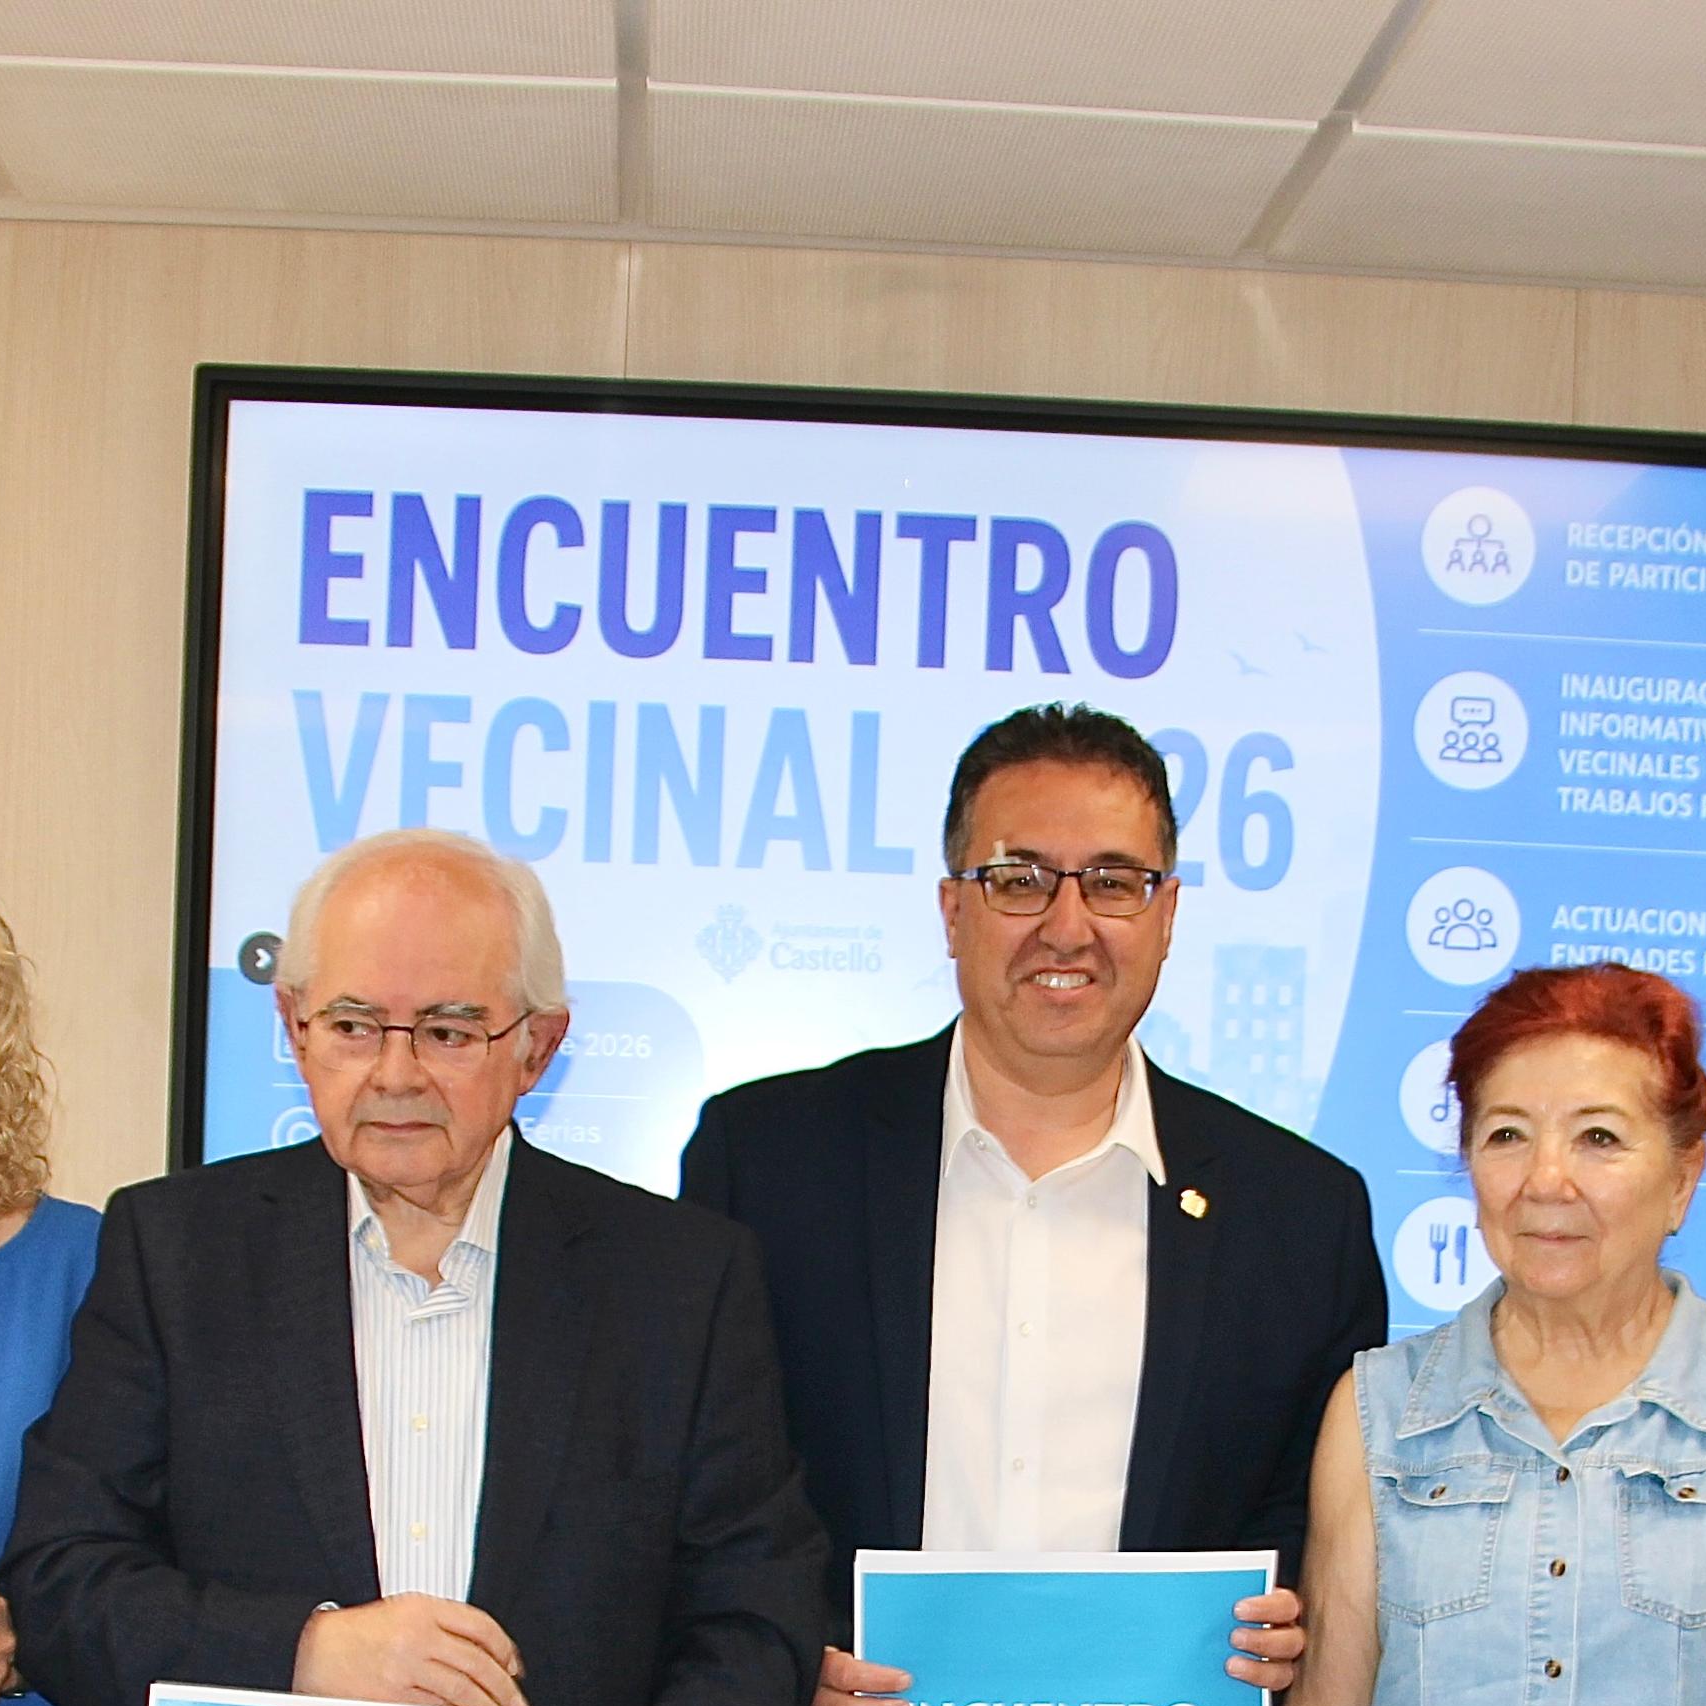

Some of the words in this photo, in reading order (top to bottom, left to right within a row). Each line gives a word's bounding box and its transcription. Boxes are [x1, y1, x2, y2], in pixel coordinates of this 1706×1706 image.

[297, 488, 1179, 679] ENCUENTRO
[1566, 561, 1600, 588] DE
[1559, 749, 1700, 781] VECINALES
[292, 689, 915, 876] VECINAL
[1153, 729, 1296, 891] 26
[1557, 787, 1693, 818] TRABAJOS
[770, 941, 883, 972] Castelló
[585, 1033, 653, 1059] 2026
[520, 1120, 603, 1144] Ferias
